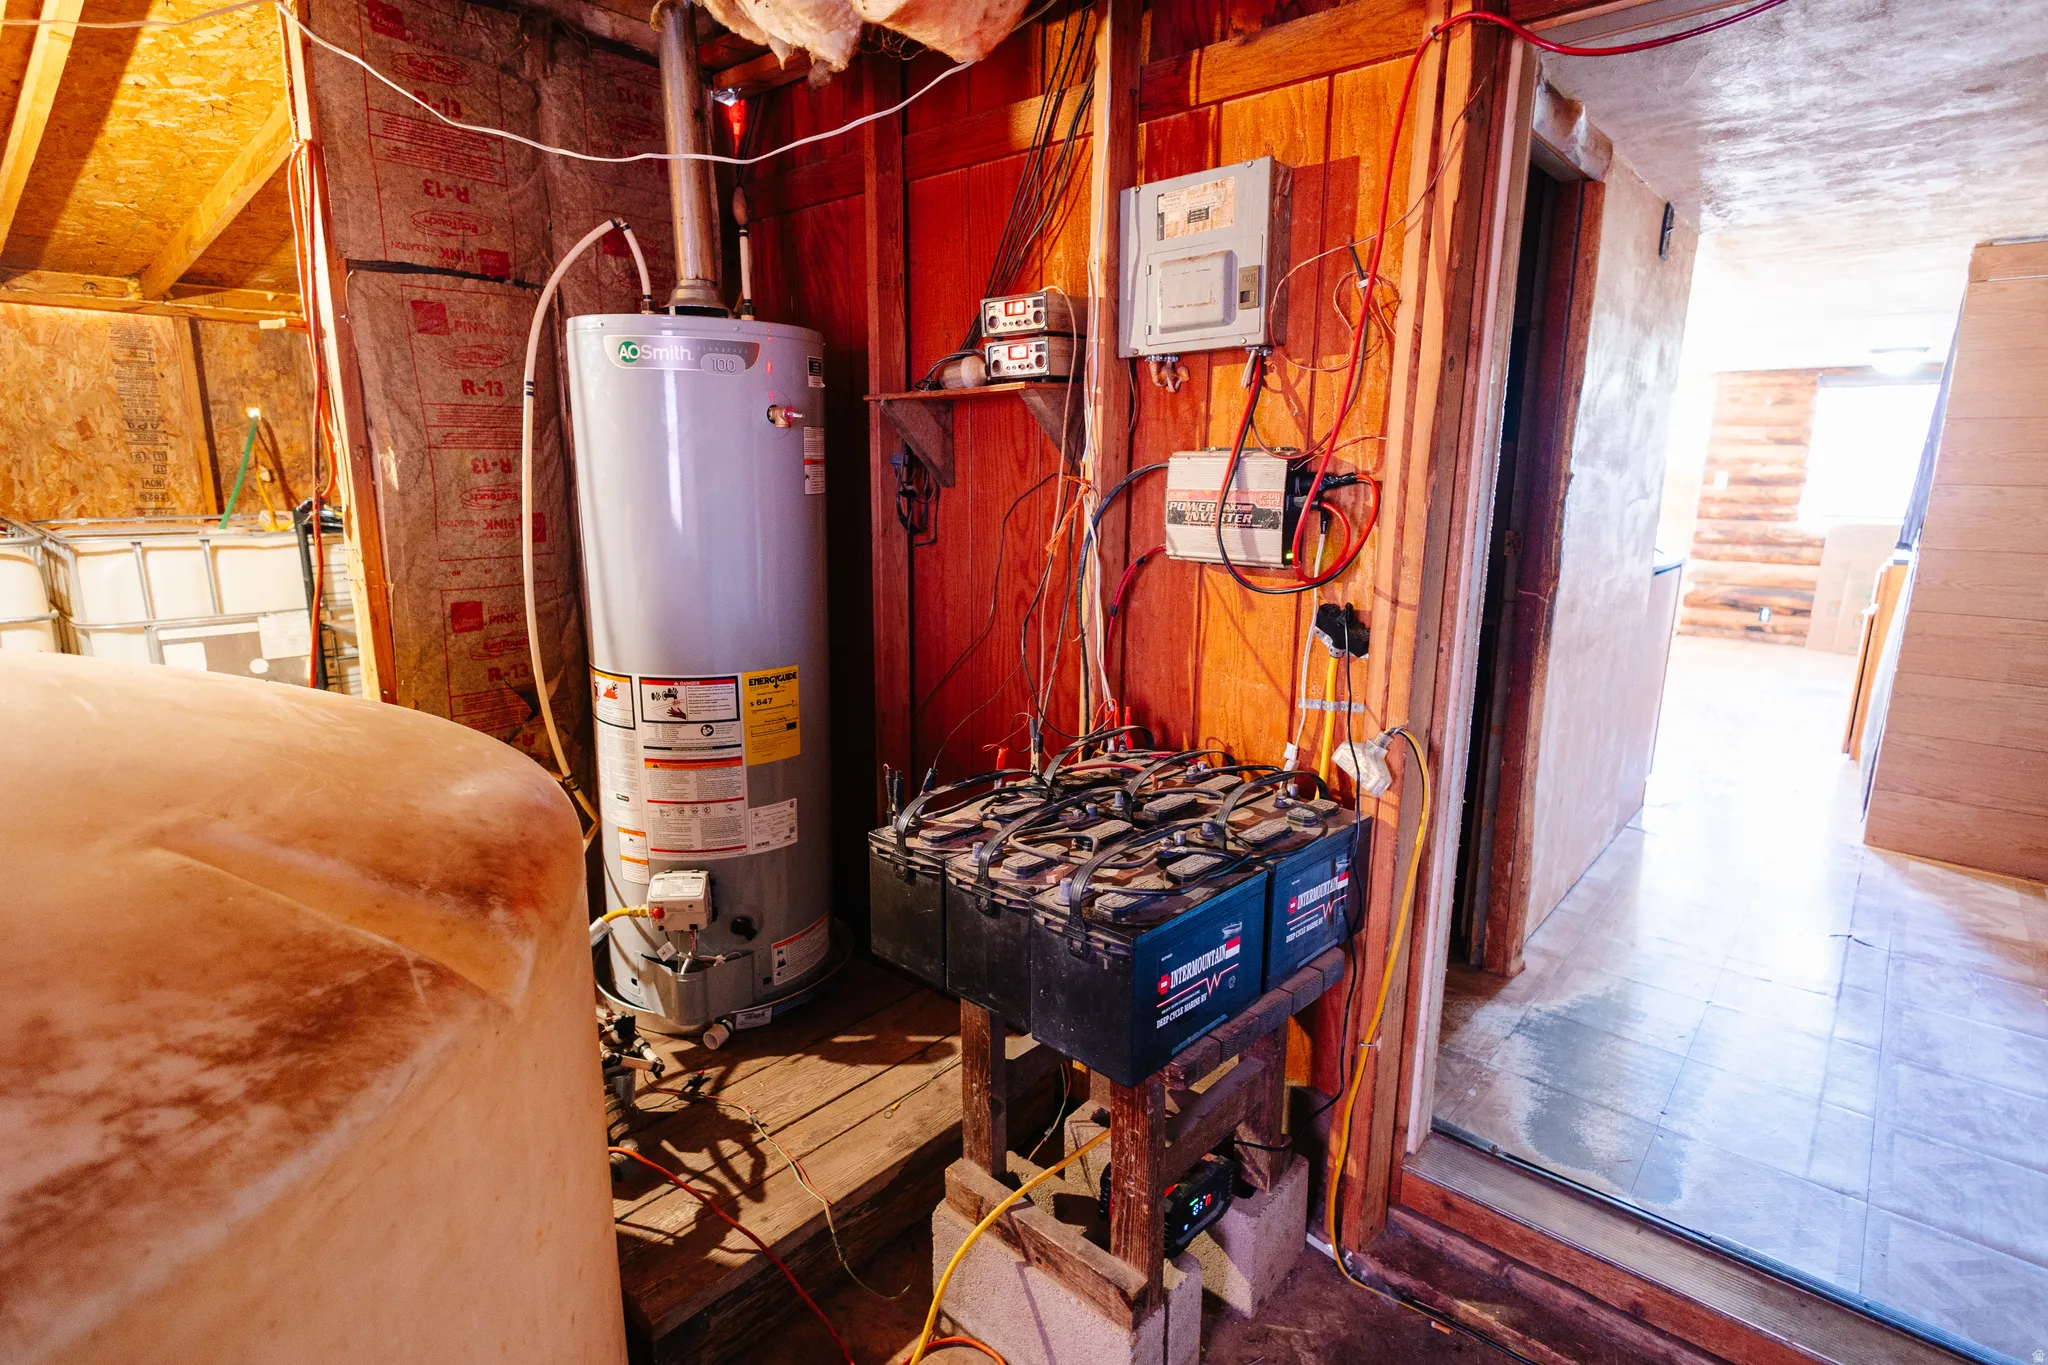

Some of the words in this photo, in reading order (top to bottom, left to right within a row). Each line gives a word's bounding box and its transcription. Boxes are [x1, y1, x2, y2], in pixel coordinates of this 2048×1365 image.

[422, 178, 470, 204] R-13
[711, 357, 736, 372] 100
[461, 379, 504, 397] R-13
[471, 458, 512, 474] R-13
[144, 479, 162, 488] NOV
[1168, 501, 1216, 512] POWER
[483, 519, 516, 530] PINK
[488, 663, 529, 683] R-13
[756, 697, 773, 706] 647
[1170, 944, 1227, 989] INTERMOUNTAIN
[1156, 1014, 1170, 1029] DEEP
[1169, 1007, 1185, 1021] CYCLE
[1184, 997, 1201, 1015] MARINE
